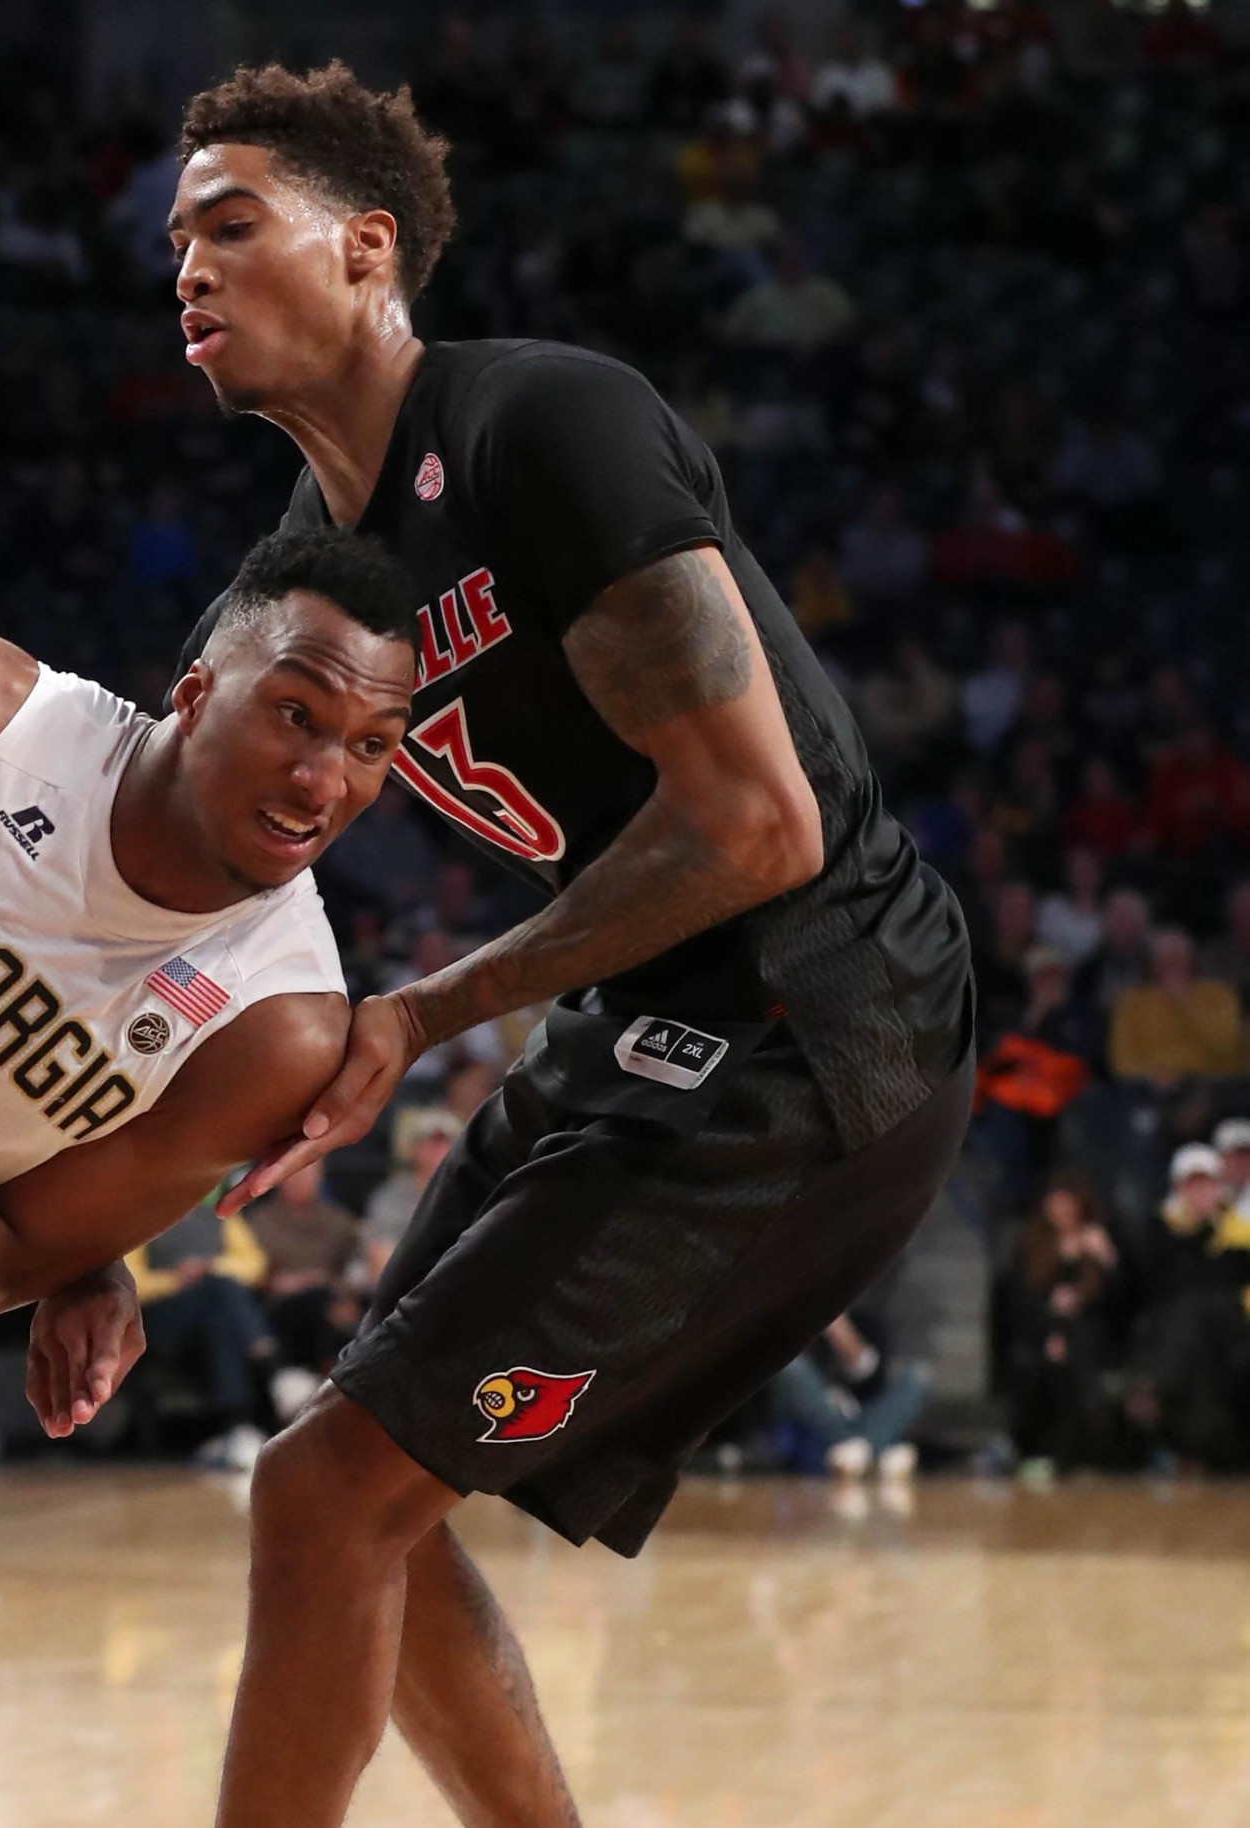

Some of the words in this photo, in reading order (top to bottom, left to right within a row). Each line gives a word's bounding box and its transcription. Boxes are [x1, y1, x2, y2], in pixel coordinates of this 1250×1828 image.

[412, 566, 513, 693] LLE
[641, 1039, 668, 1053] adidas
[682, 1043, 704, 1059] 2XL
